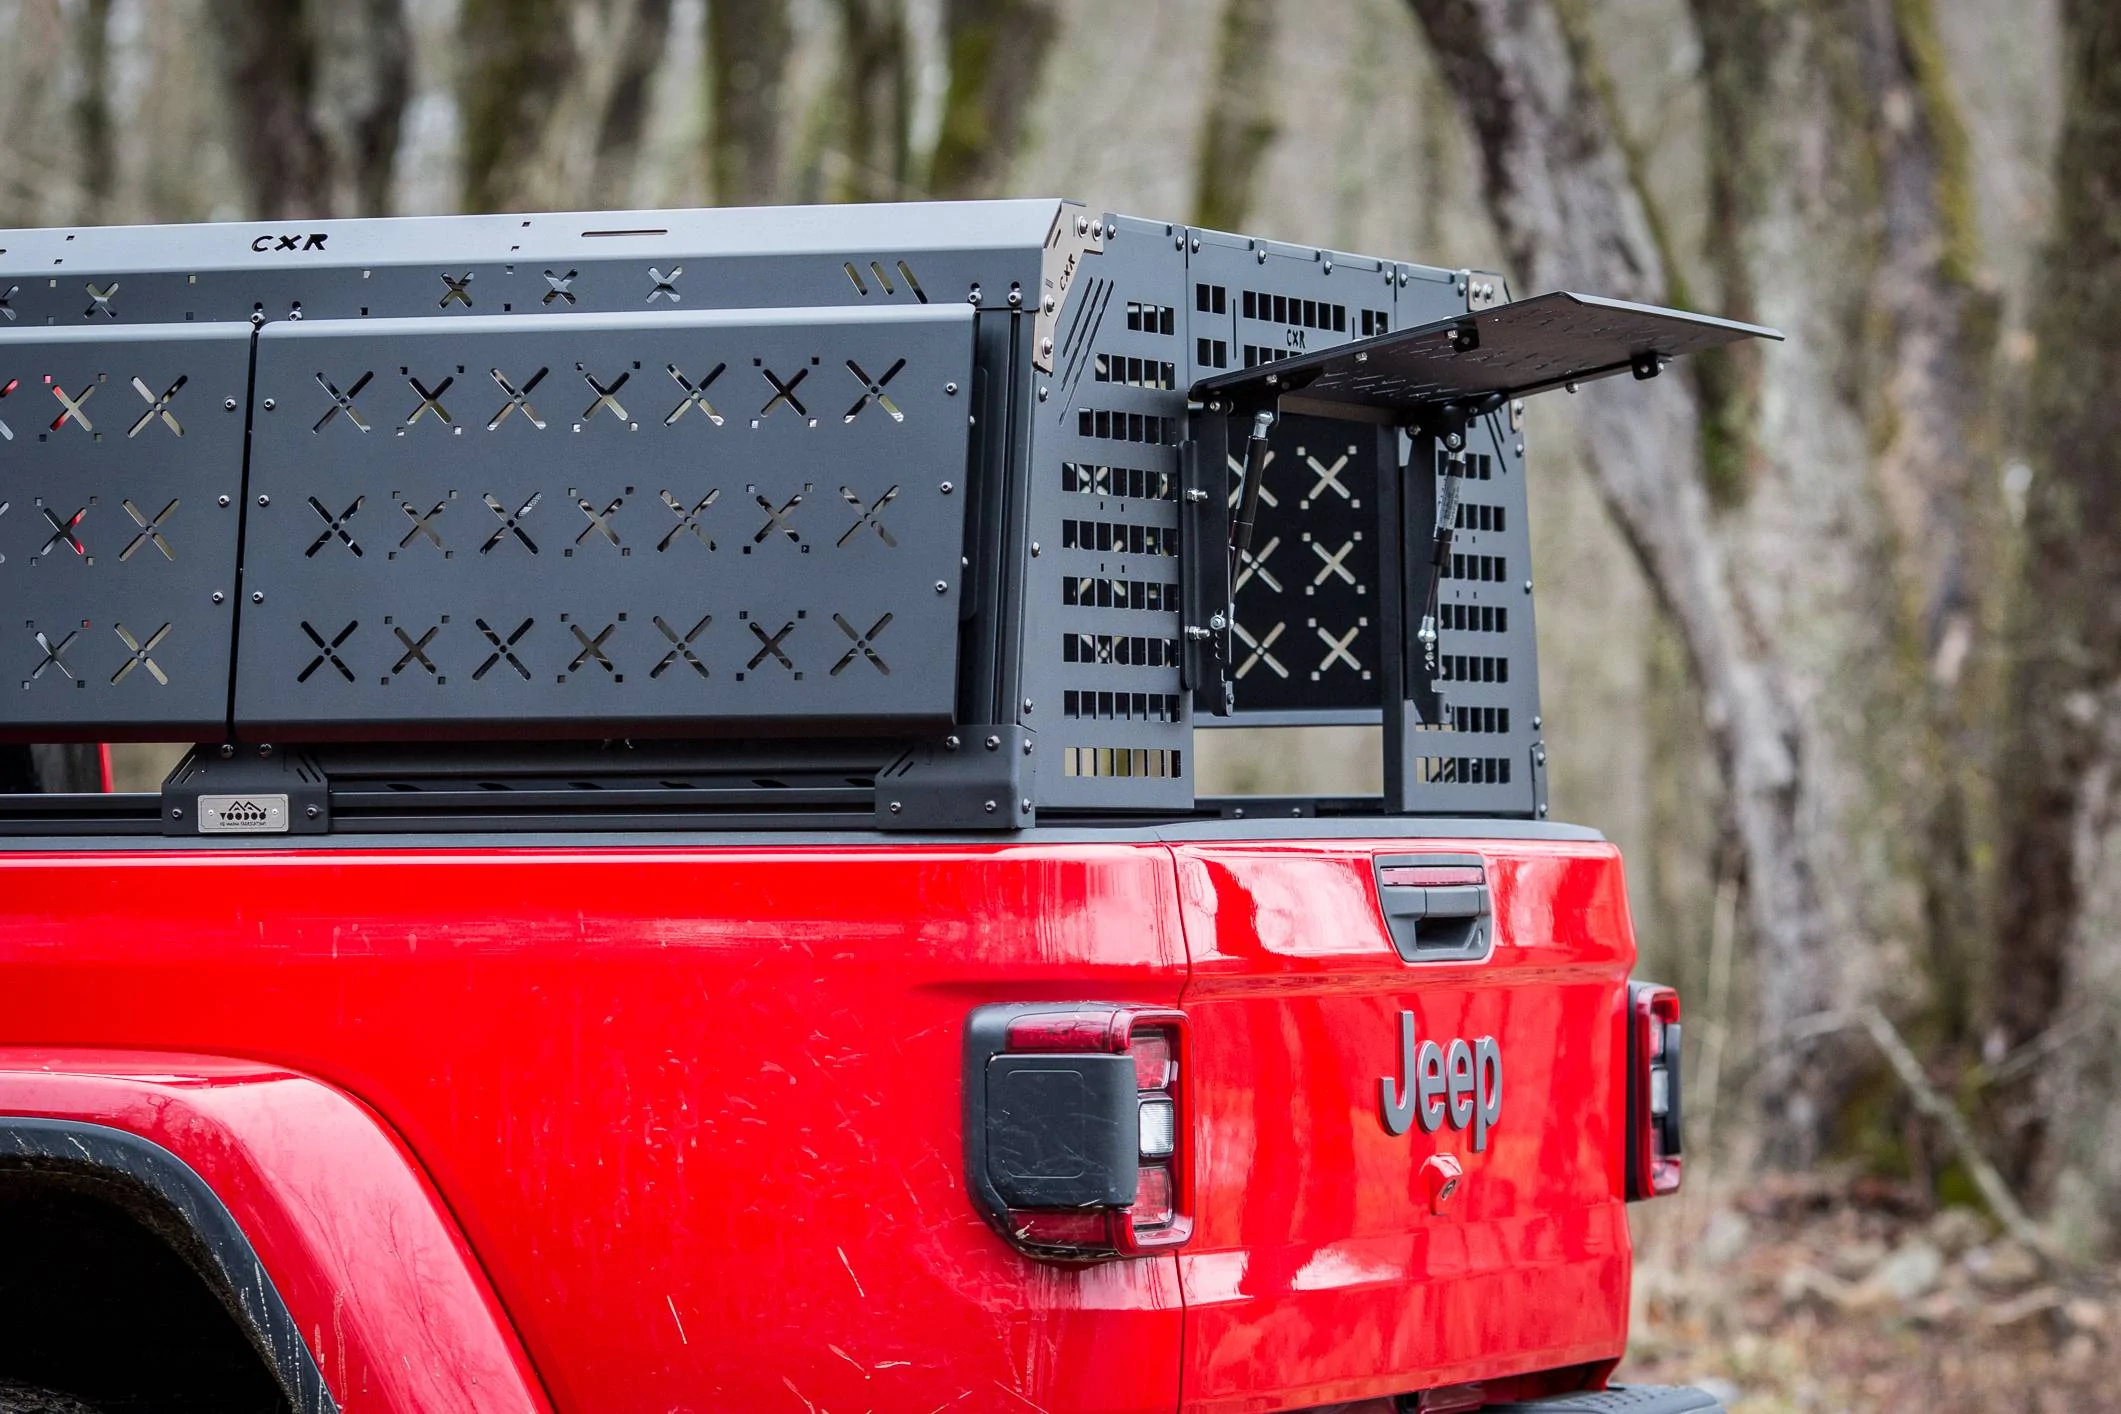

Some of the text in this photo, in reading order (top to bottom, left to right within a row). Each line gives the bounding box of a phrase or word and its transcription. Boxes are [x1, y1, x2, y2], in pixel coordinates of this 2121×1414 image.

[251, 233, 329, 252] CXR
[1286, 328, 1306, 349] CXR
[219, 810, 267, 821] VOODOO
[1378, 1010, 1503, 1153] Jeep
